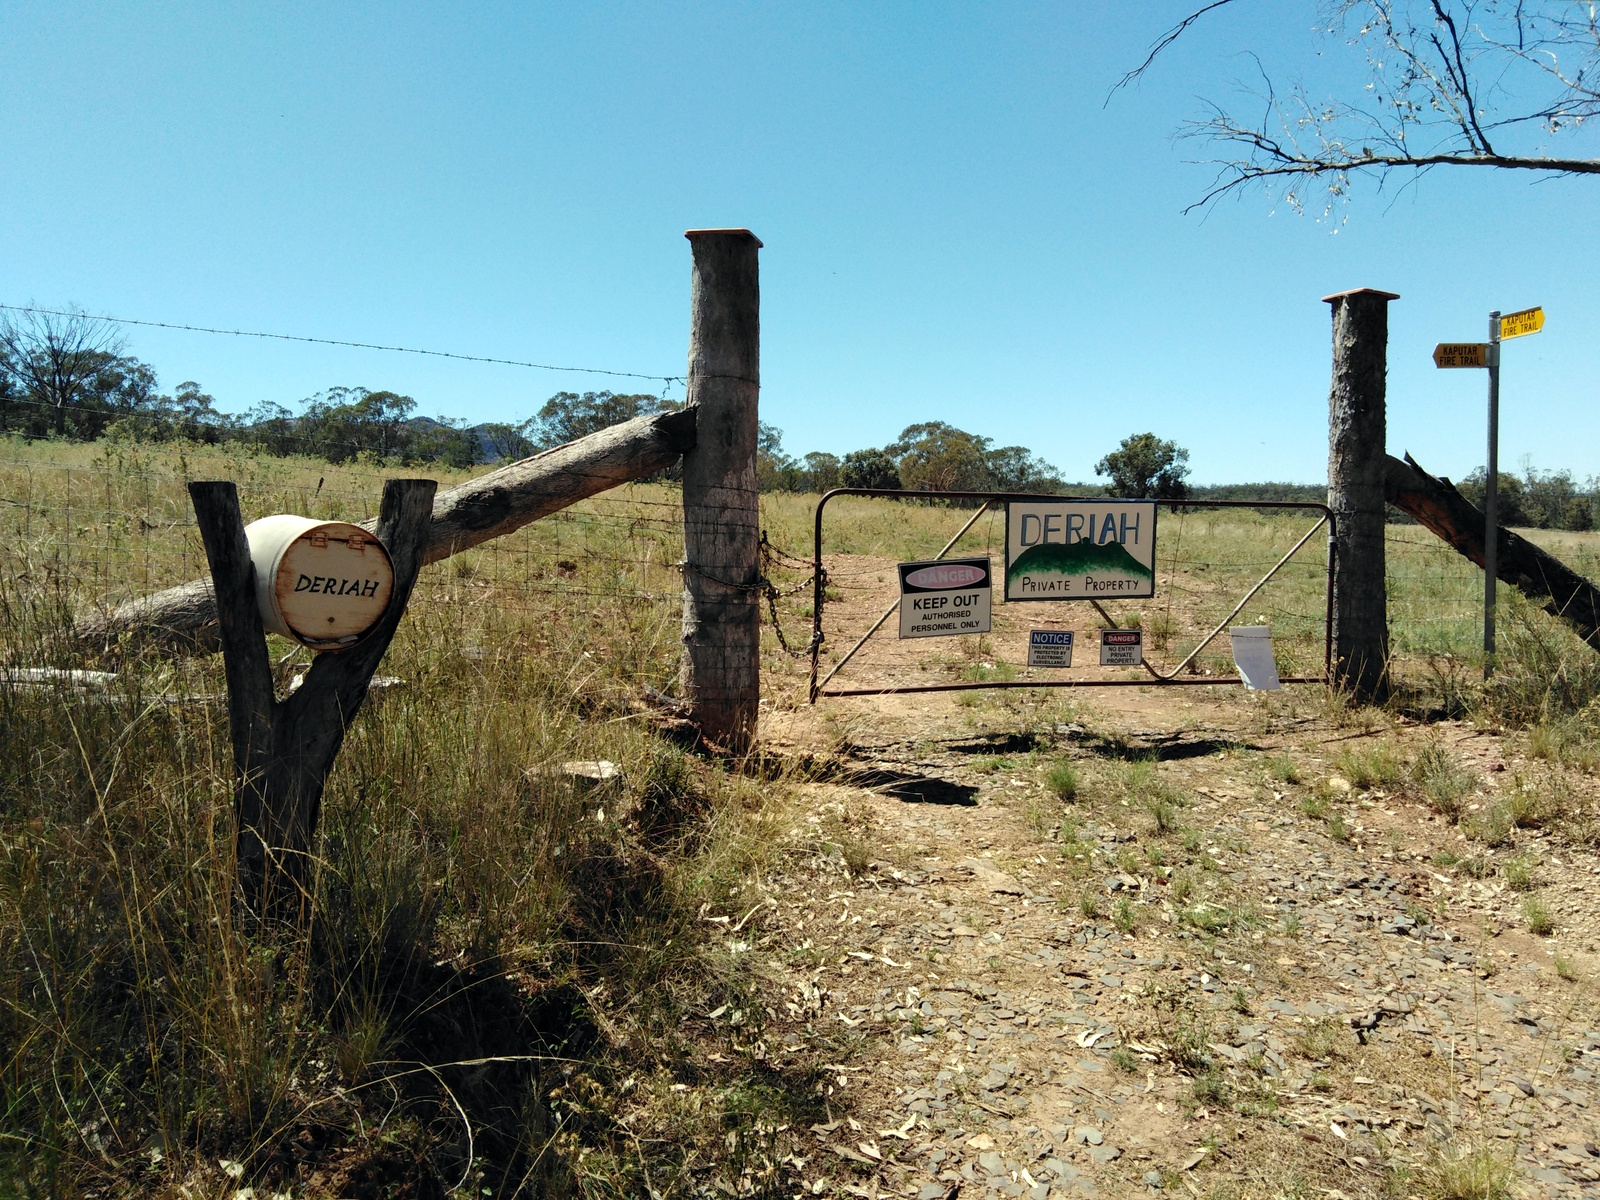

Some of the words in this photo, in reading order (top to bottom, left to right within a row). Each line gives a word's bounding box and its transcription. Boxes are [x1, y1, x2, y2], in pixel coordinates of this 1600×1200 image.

[1506, 311, 1536, 326] KAPUTAR
[1503, 326, 1517, 337] FIRE
[1520, 321, 1539, 333] TRAIL
[1443, 346, 1478, 356] KAPUTAR
[1439, 356, 1456, 366] FIRE
[1460, 356, 1481, 366] TRAIL
[1020, 512, 1139, 546] DERIAH
[917, 569, 975, 584] DANGER
[294, 574, 379, 598] DERIAH
[913, 597, 948, 610] KEEP
[953, 594, 980, 607] OUT
[922, 610, 971, 621] AUTHORISED
[911, 622, 957, 633] PERSONNEL
[960, 620, 980, 629] ONLY
[1033, 633, 1070, 644] NOTICE
